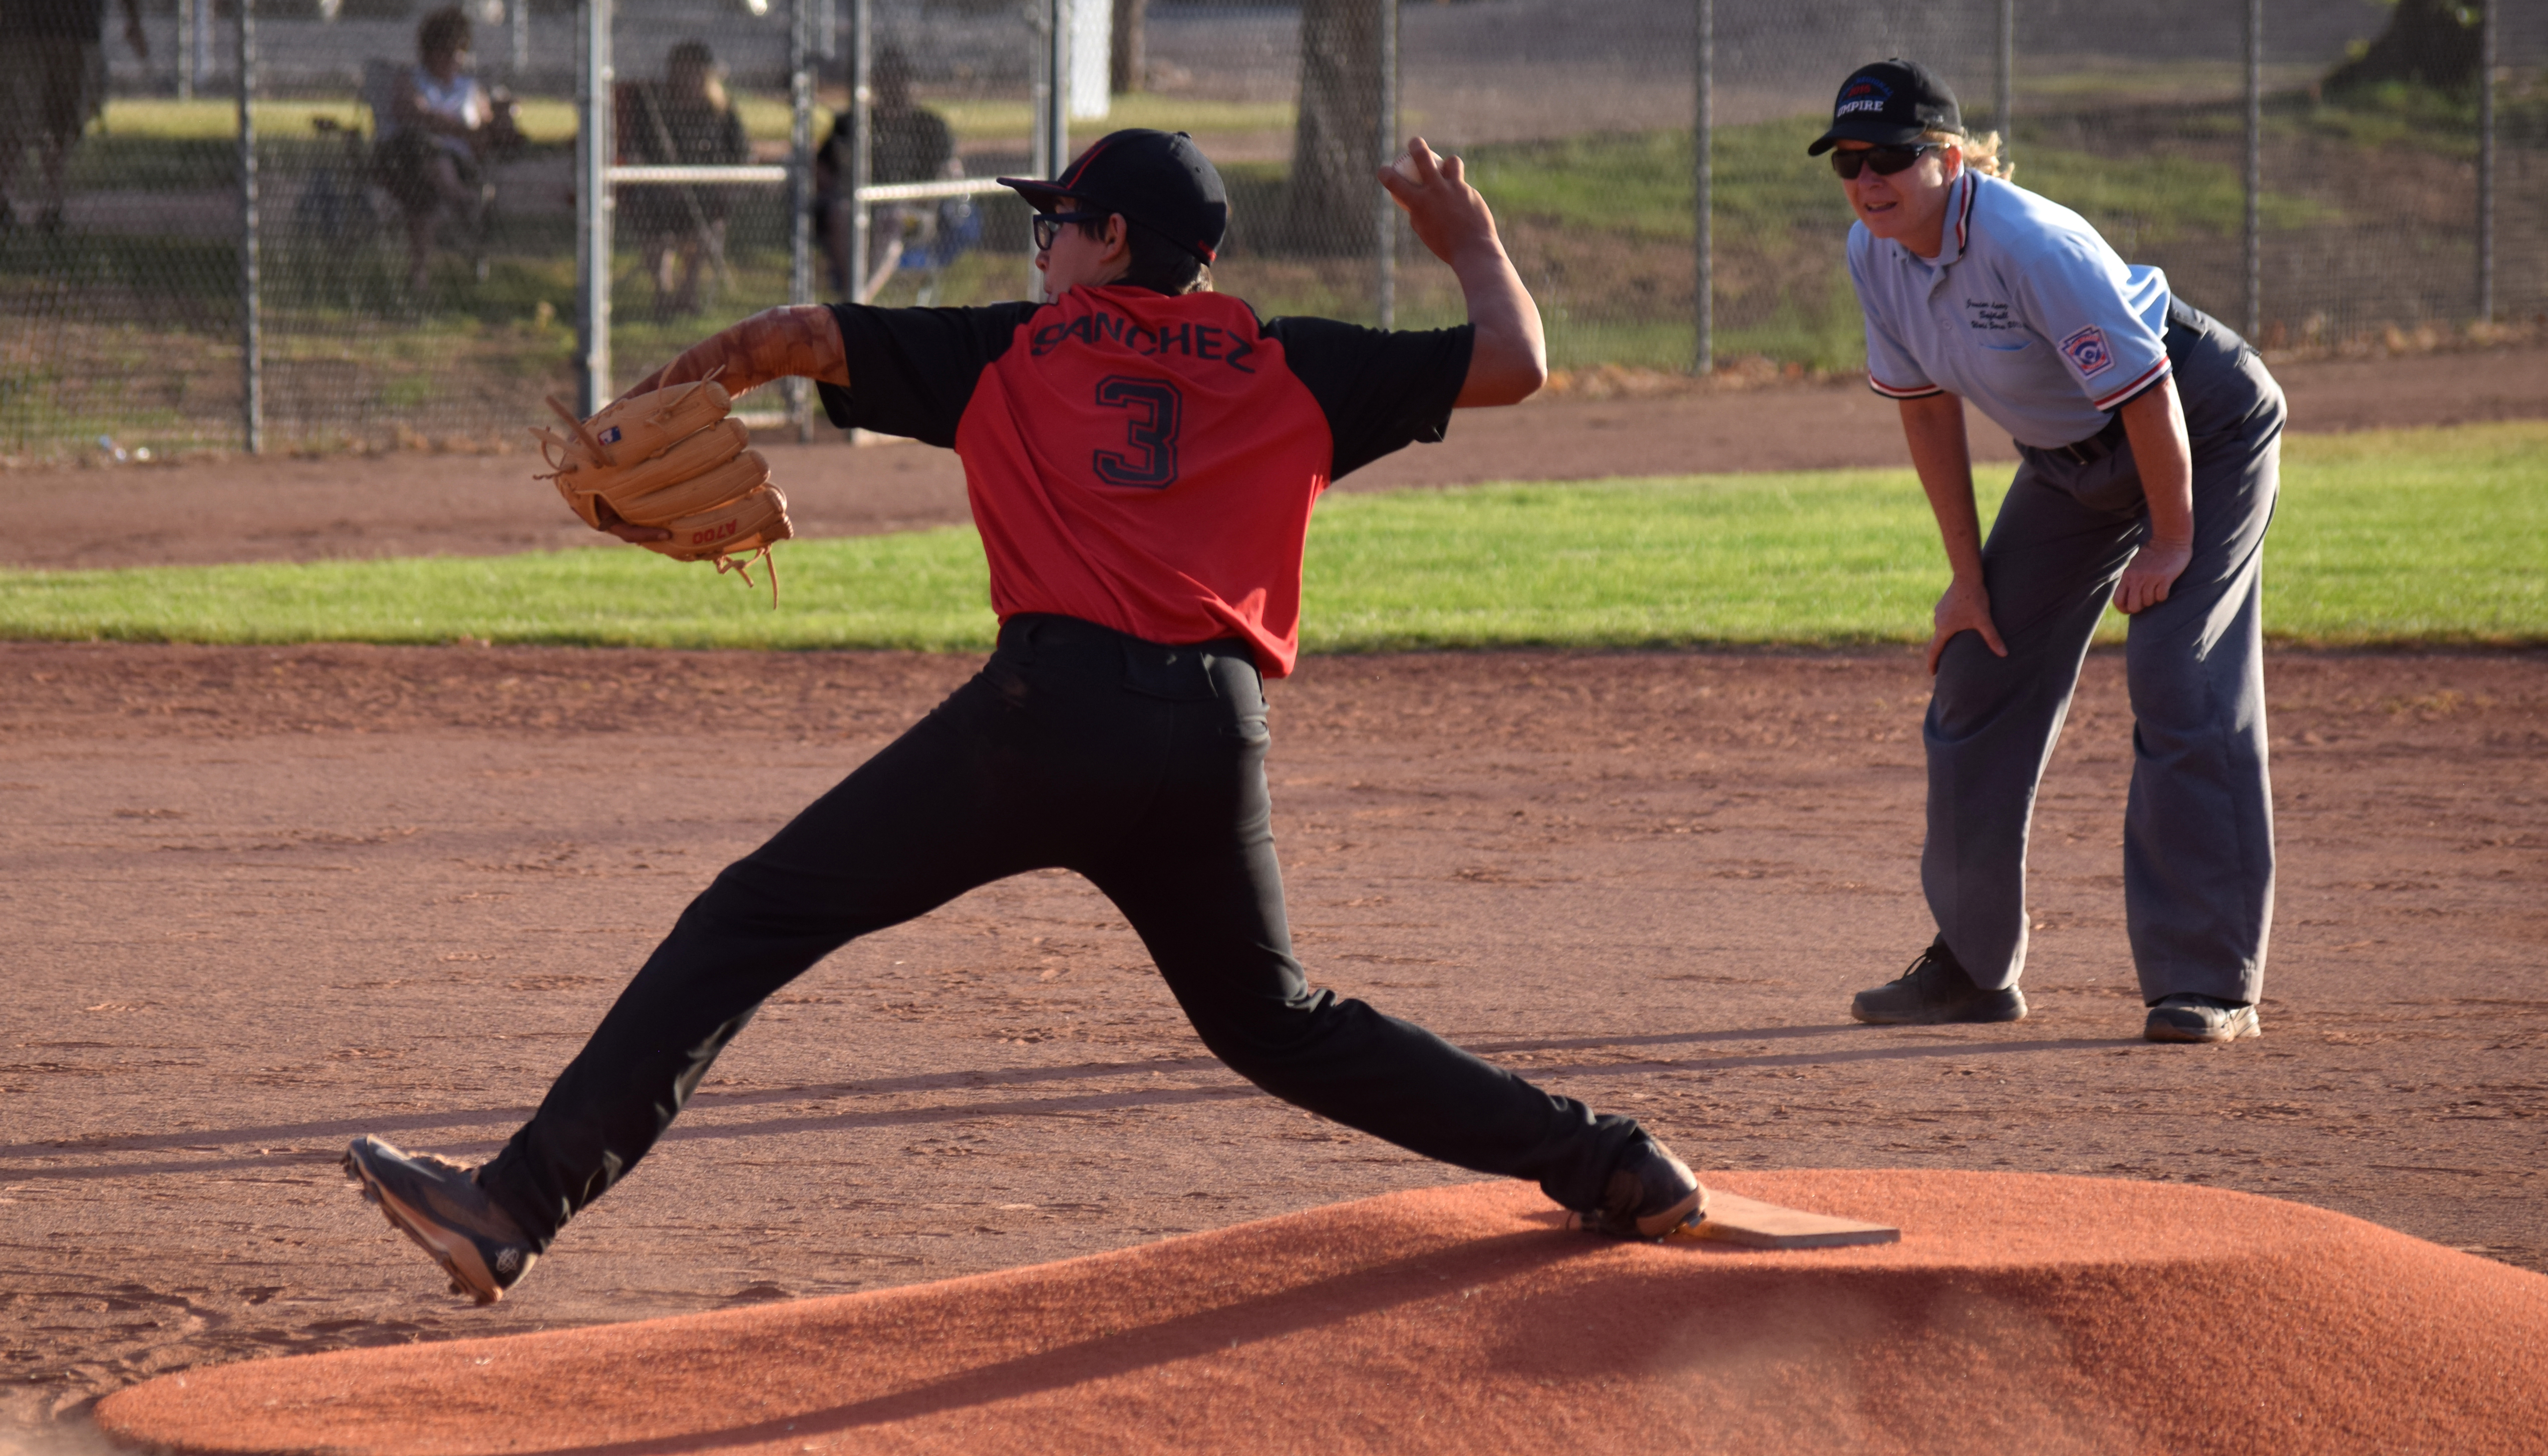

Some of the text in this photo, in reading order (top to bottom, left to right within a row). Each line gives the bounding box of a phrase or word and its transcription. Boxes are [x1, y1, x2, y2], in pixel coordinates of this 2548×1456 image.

[1837, 100, 1884, 118] UMPIRE
[1031, 312, 1255, 374] SANCHEZ
[1093, 375, 1183, 490] 3
[693, 518, 737, 545] A700
